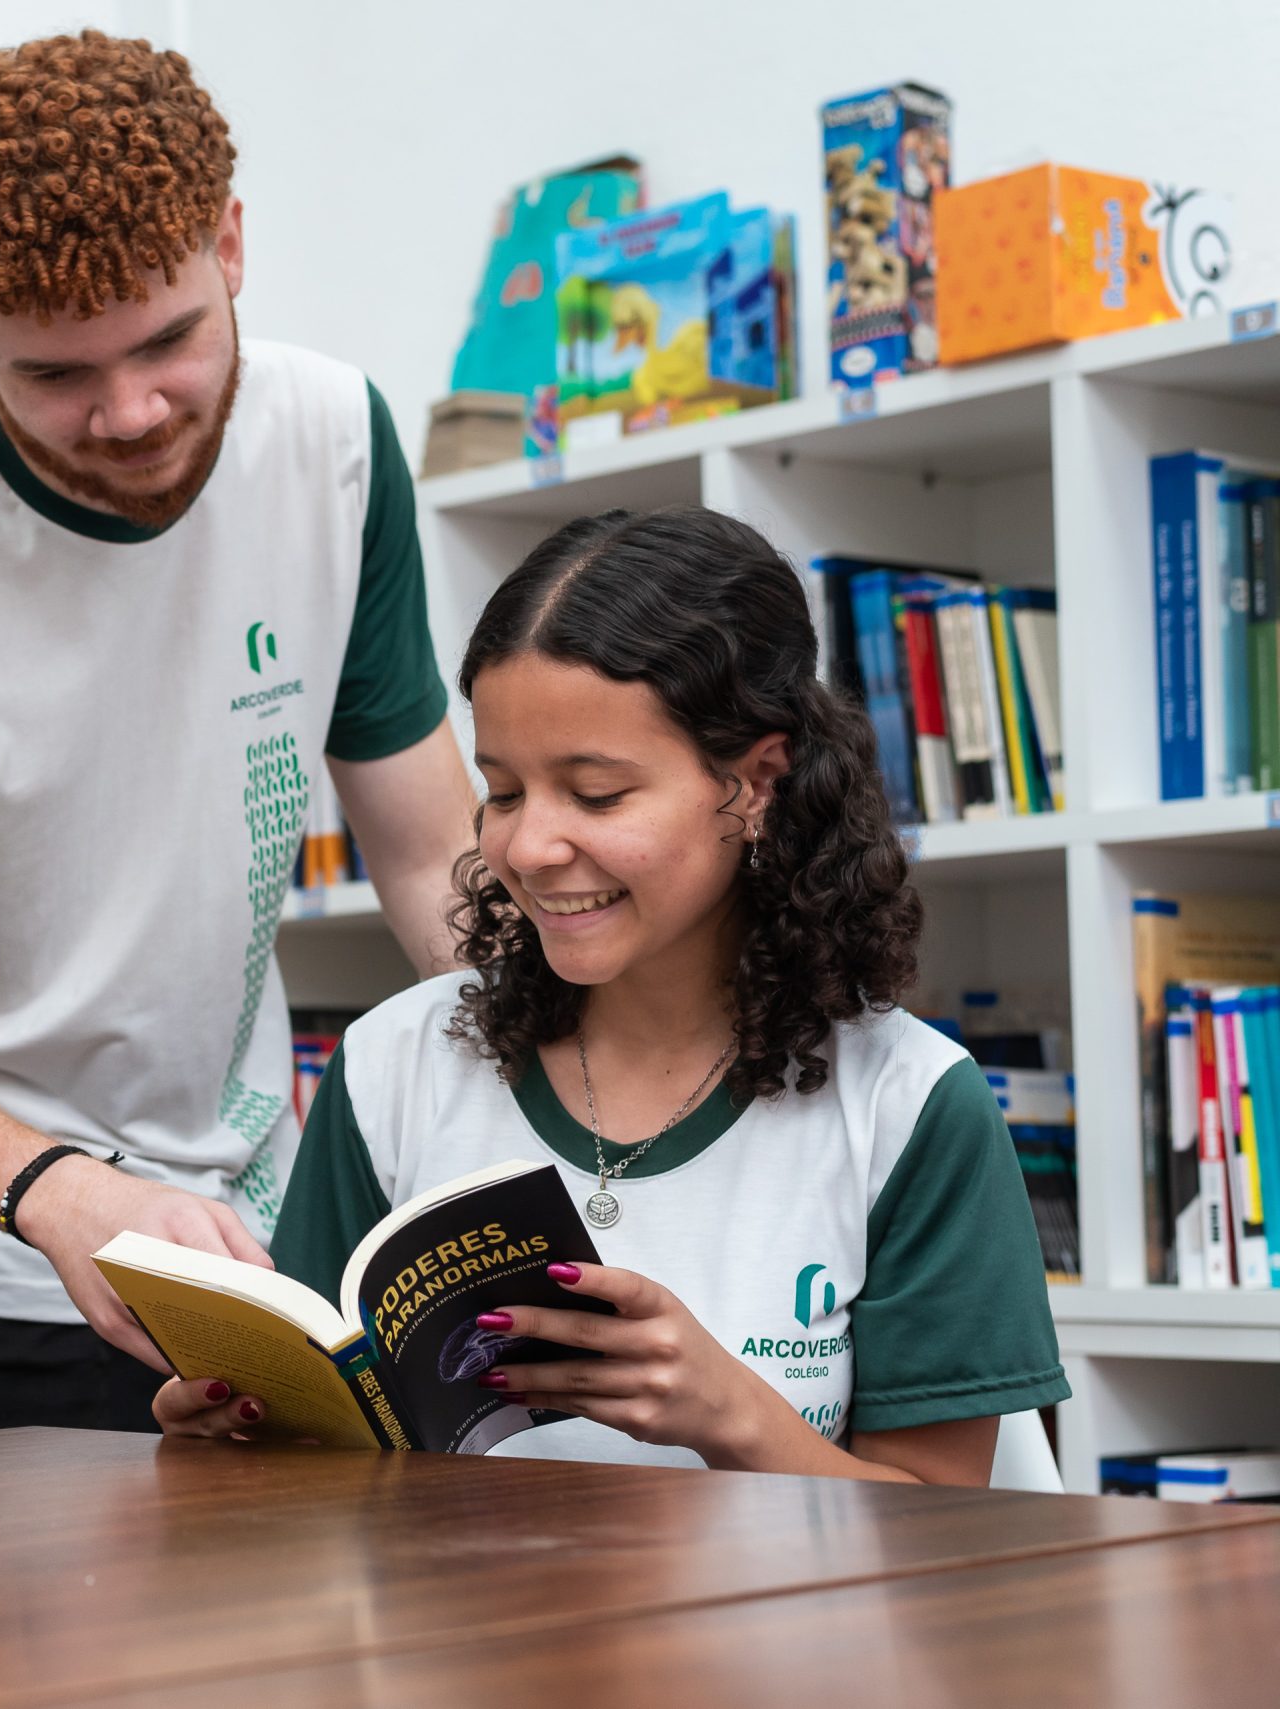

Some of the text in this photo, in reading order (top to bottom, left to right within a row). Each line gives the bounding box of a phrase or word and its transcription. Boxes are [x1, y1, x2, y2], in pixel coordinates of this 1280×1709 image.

[231, 679, 304, 712] ARCOVERDE
[375, 1223, 507, 1336] PODERES
[385, 1235, 549, 1353] PARANORMAIS
[741, 1332, 850, 1358] ARCOVERDE
[785, 1365, 829, 1379] COLÉGIO
[455, 1413, 476, 1437] Diane
